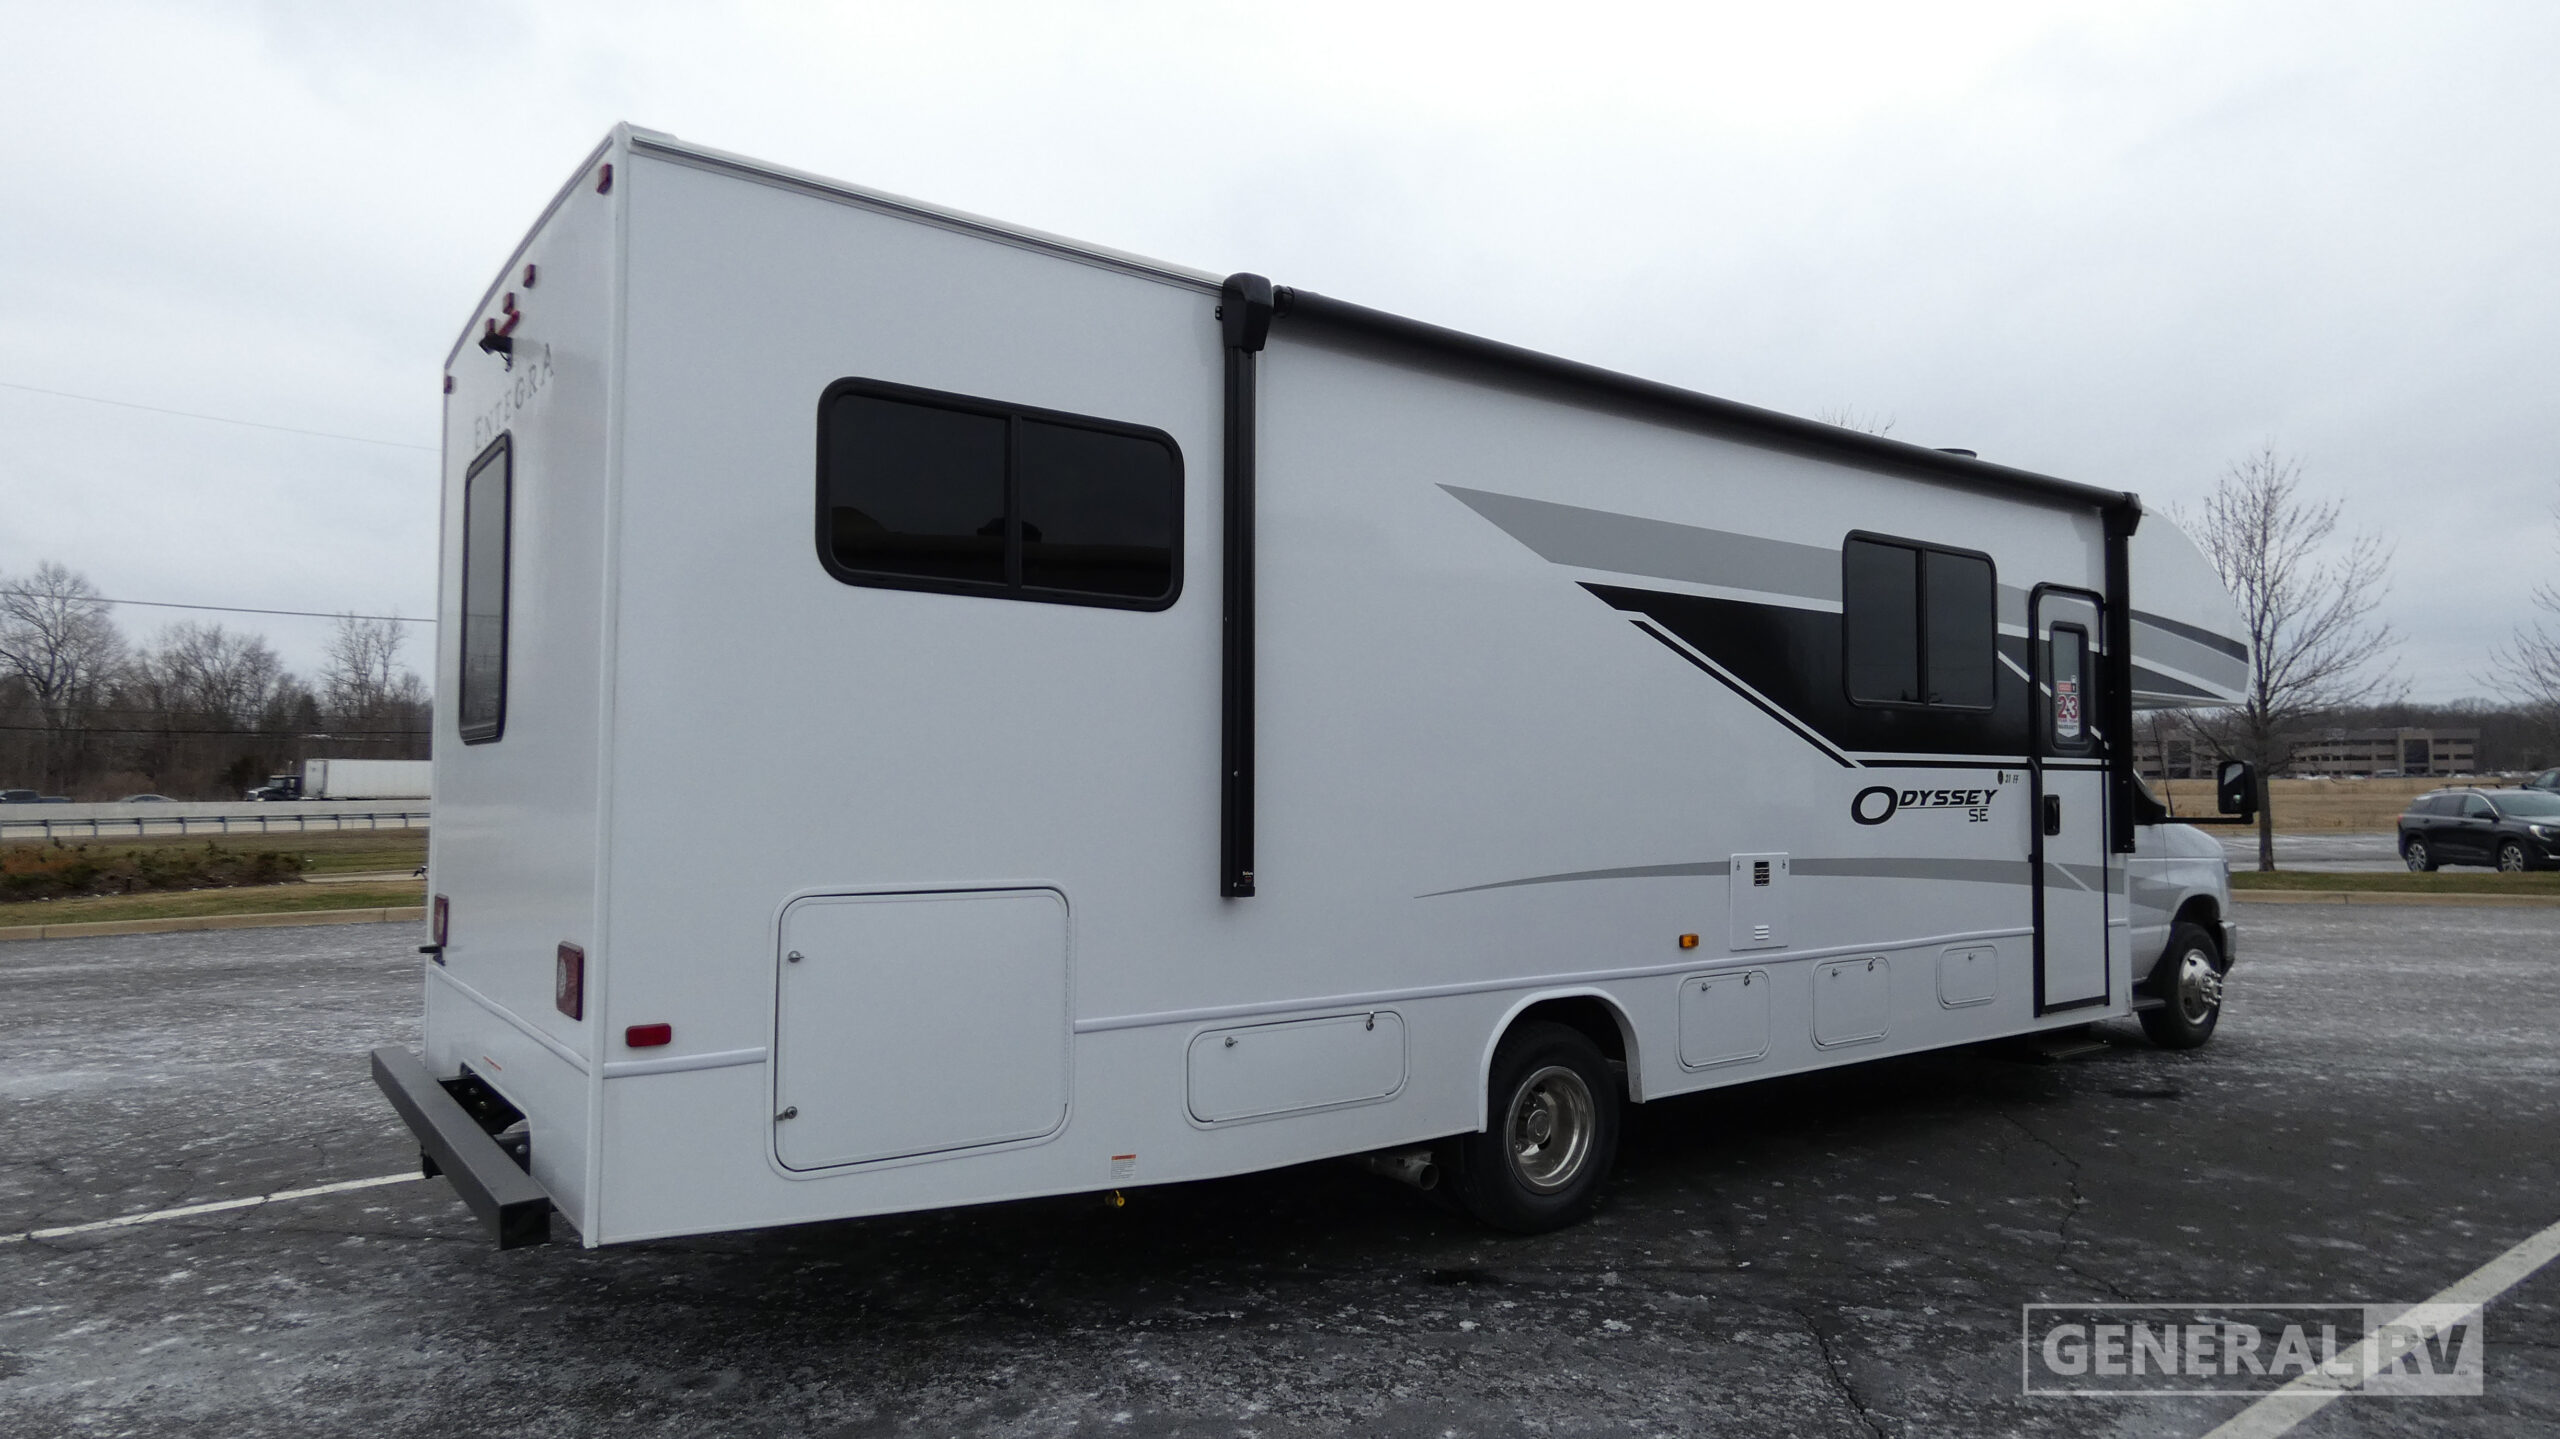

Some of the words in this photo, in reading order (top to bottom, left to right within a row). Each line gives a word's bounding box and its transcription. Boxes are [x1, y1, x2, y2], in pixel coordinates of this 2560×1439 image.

[474, 342, 554, 451] ENTEGRA
[1851, 786, 1998, 826] ODYSSEY
[1968, 808, 1989, 822] SE
